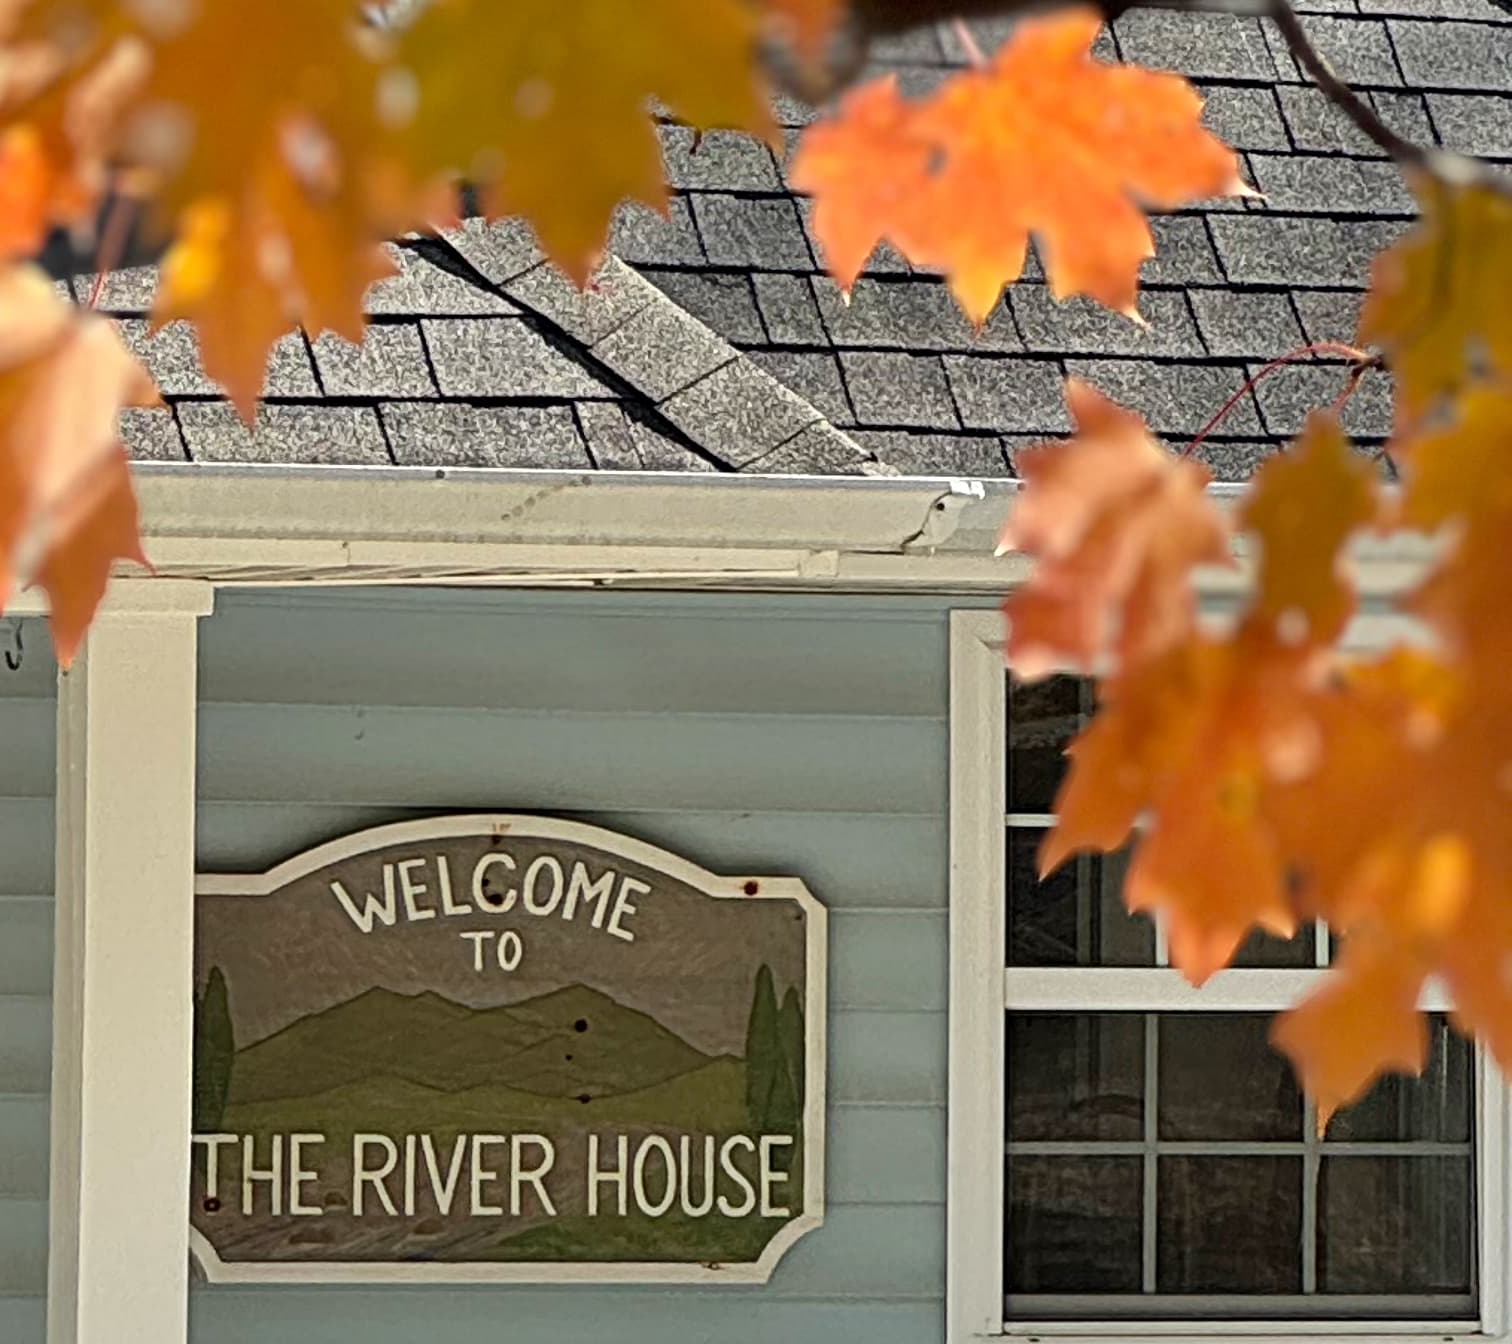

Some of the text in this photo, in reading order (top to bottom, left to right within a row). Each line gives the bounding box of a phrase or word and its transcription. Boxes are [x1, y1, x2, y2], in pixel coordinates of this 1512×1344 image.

[330, 852, 652, 942] WELCOME
[460, 930, 523, 972] TO
[191, 1133, 794, 1218] THE RIVER HOUSE
